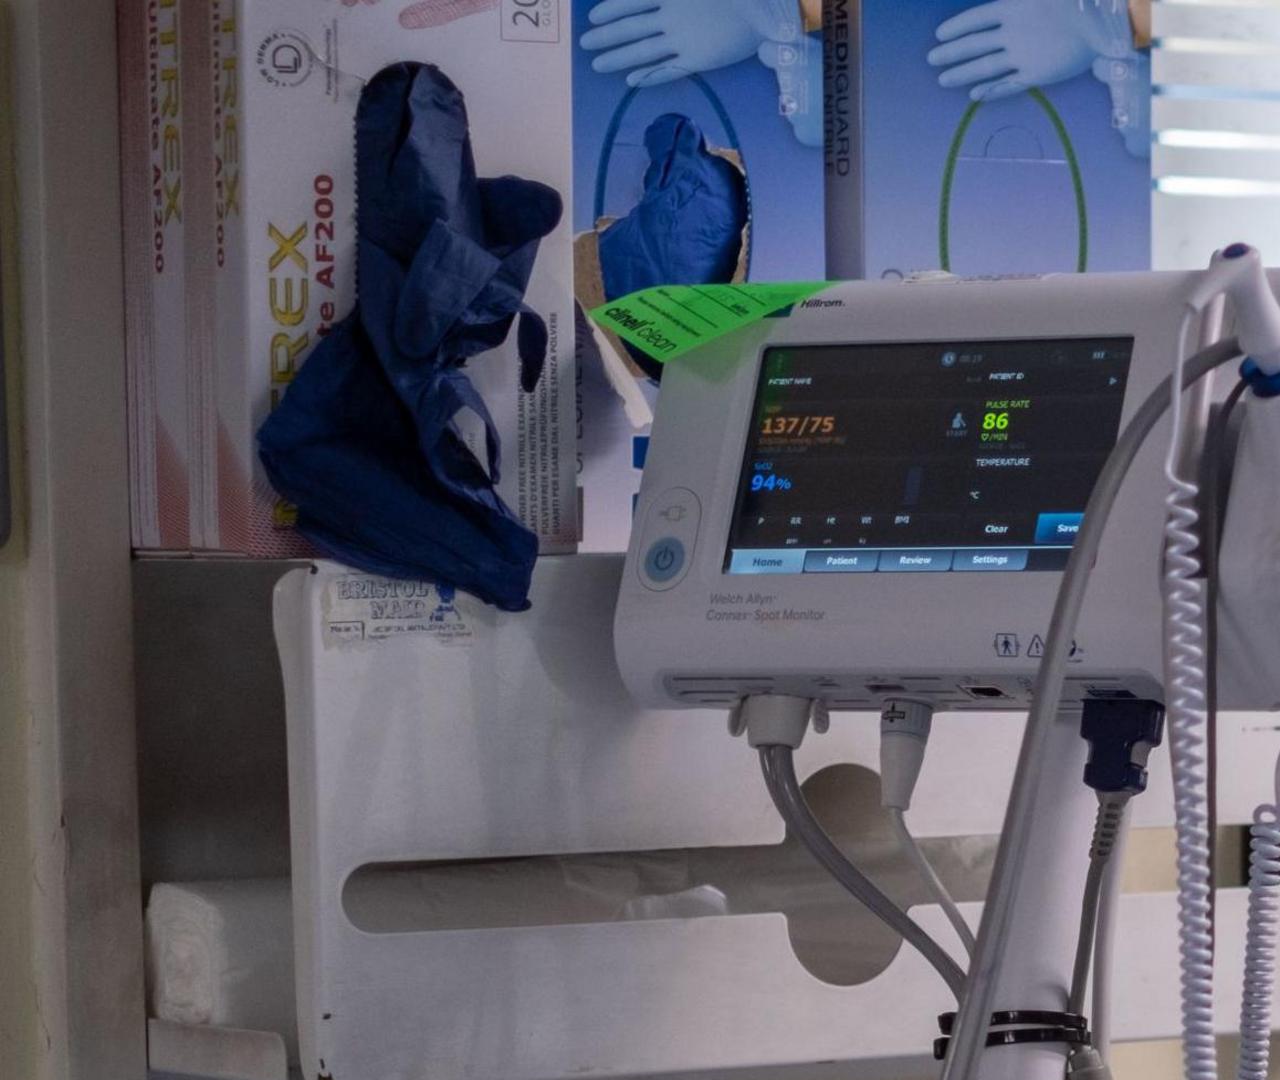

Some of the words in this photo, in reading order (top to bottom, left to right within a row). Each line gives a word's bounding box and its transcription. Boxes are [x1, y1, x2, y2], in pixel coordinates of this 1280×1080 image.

[835, 0, 851, 177] MEDIGUARD
[152, 164, 165, 274] AF200
[314, 174, 335, 290] AF200
[985, 400, 1009, 409] PULSE
[1009, 399, 1031, 408] RATE
[761, 415, 836, 437] 137/75
[982, 412, 1009, 430] 86
[517, 433, 526, 468] NITRILE
[976, 457, 1031, 467] TEMPERATURE
[518, 471, 527, 493] FREE
[551, 479, 560, 498] PER
[984, 524, 1009, 534] Clear
[1057, 524, 1080, 533] Save
[752, 557, 783, 567] Home
[826, 556, 859, 566] Patient
[899, 555, 932, 565] Review
[972, 555, 1008, 566] Settings
[709, 592, 743, 605] Welch
[753, 609, 781, 623] Spot
[782, 609, 826, 621] Monitor
